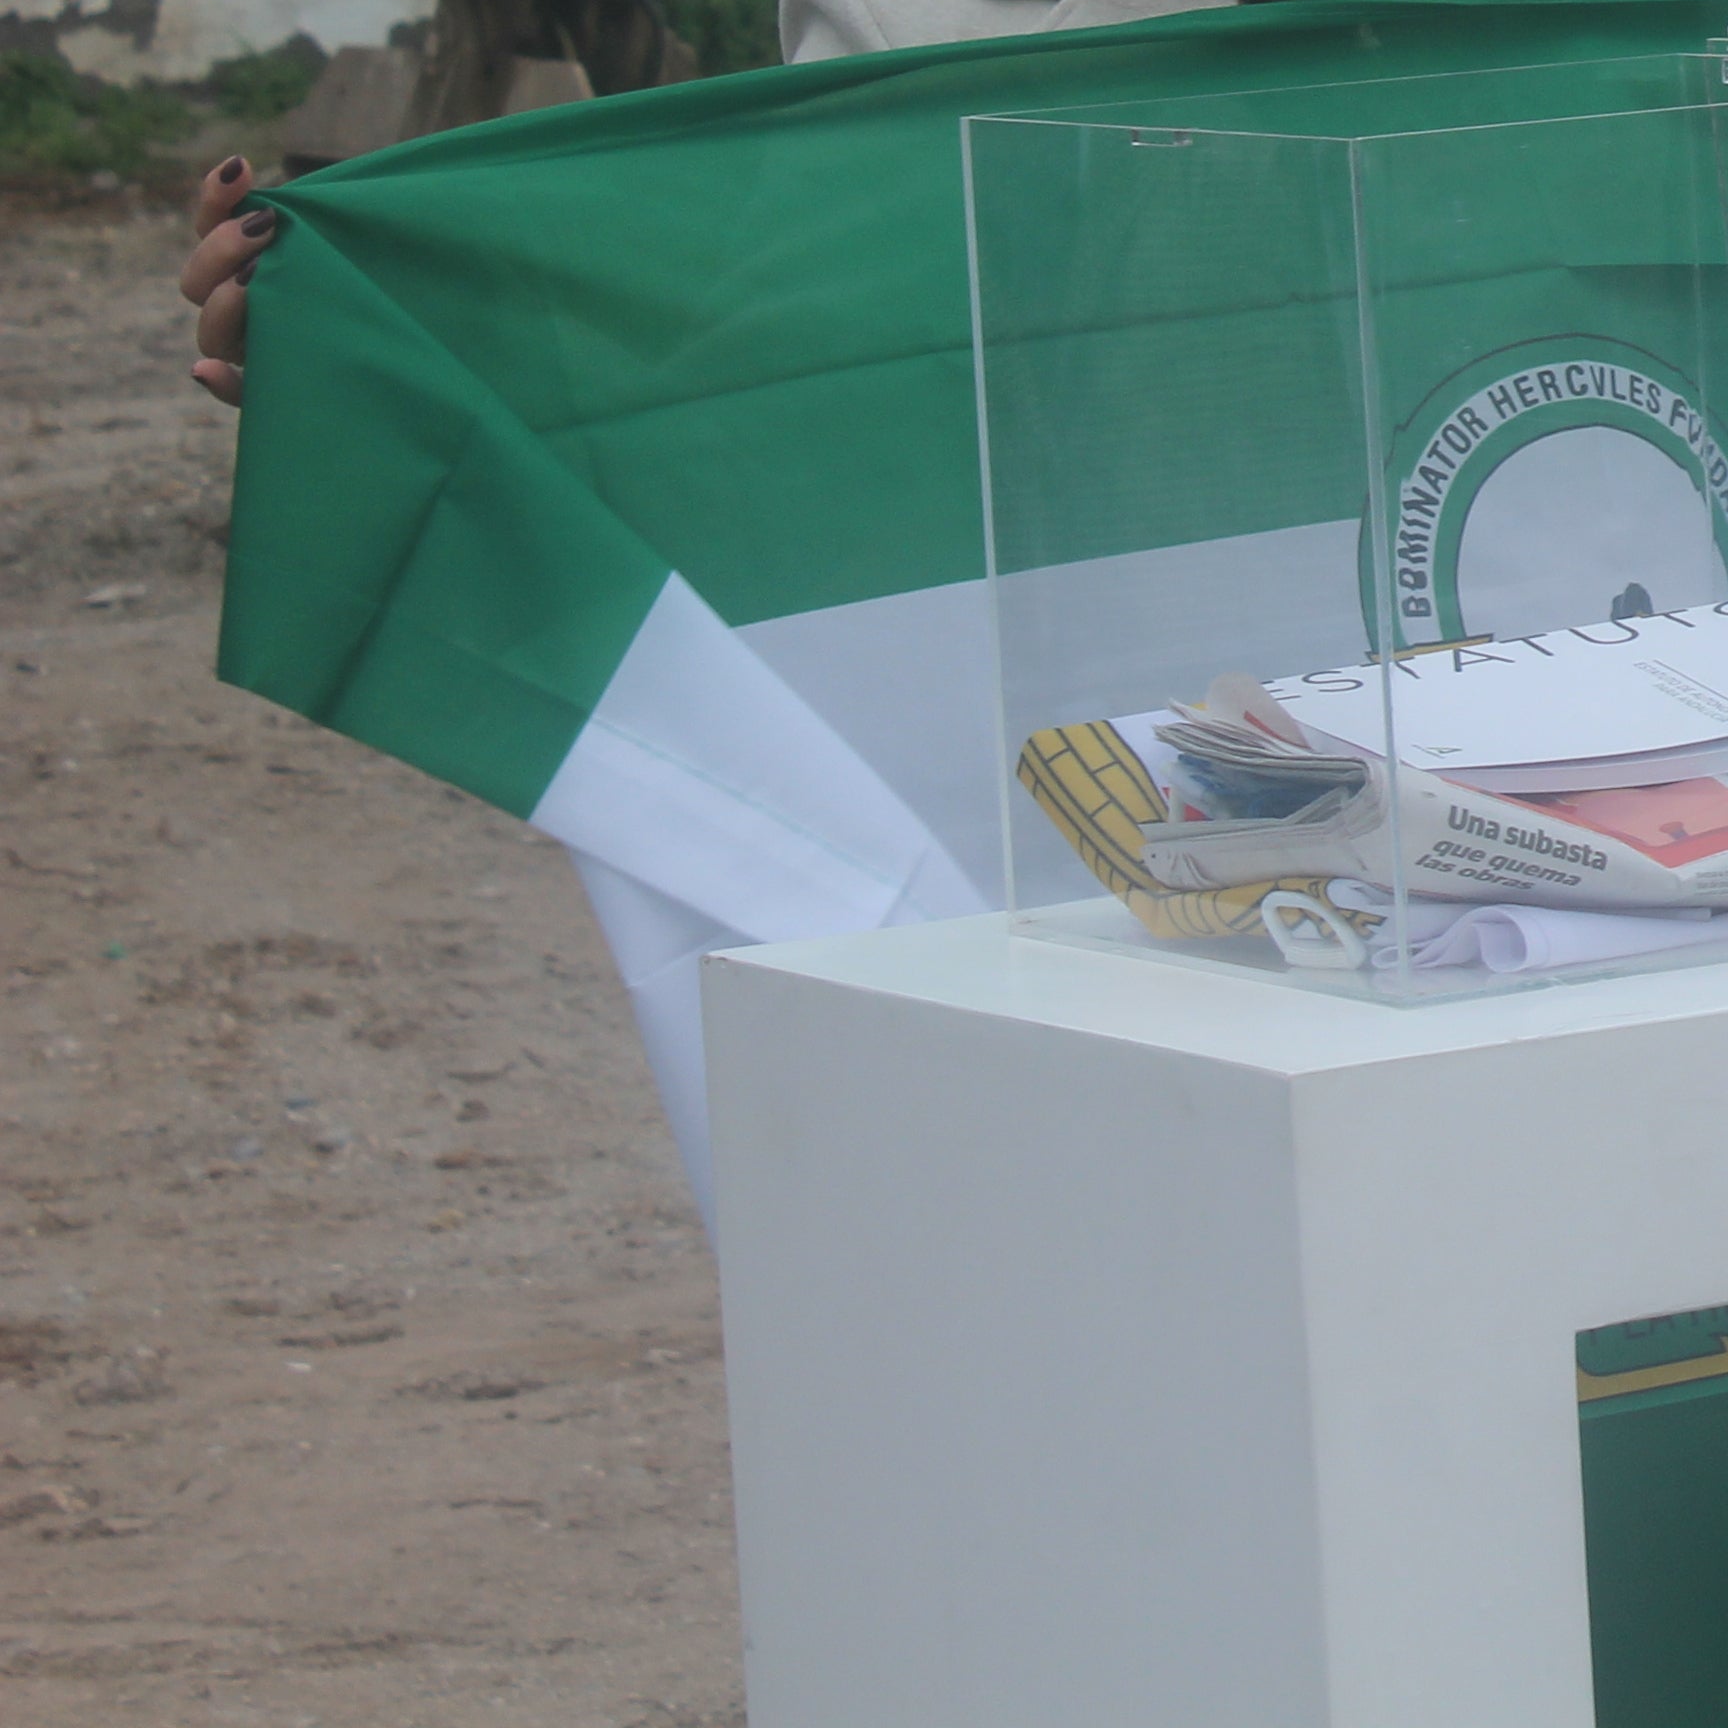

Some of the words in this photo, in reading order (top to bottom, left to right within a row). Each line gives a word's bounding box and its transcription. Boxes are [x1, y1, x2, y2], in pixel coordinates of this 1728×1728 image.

[1488, 364, 1661, 419] HERCVLES
[1432, 839, 1487, 863] que
[1488, 854, 1583, 888] quema
[1447, 804, 1501, 841] Una
[1503, 824, 1609, 871] subasta
[1415, 853, 1456, 874] las
[1457, 867, 1537, 891] obras
